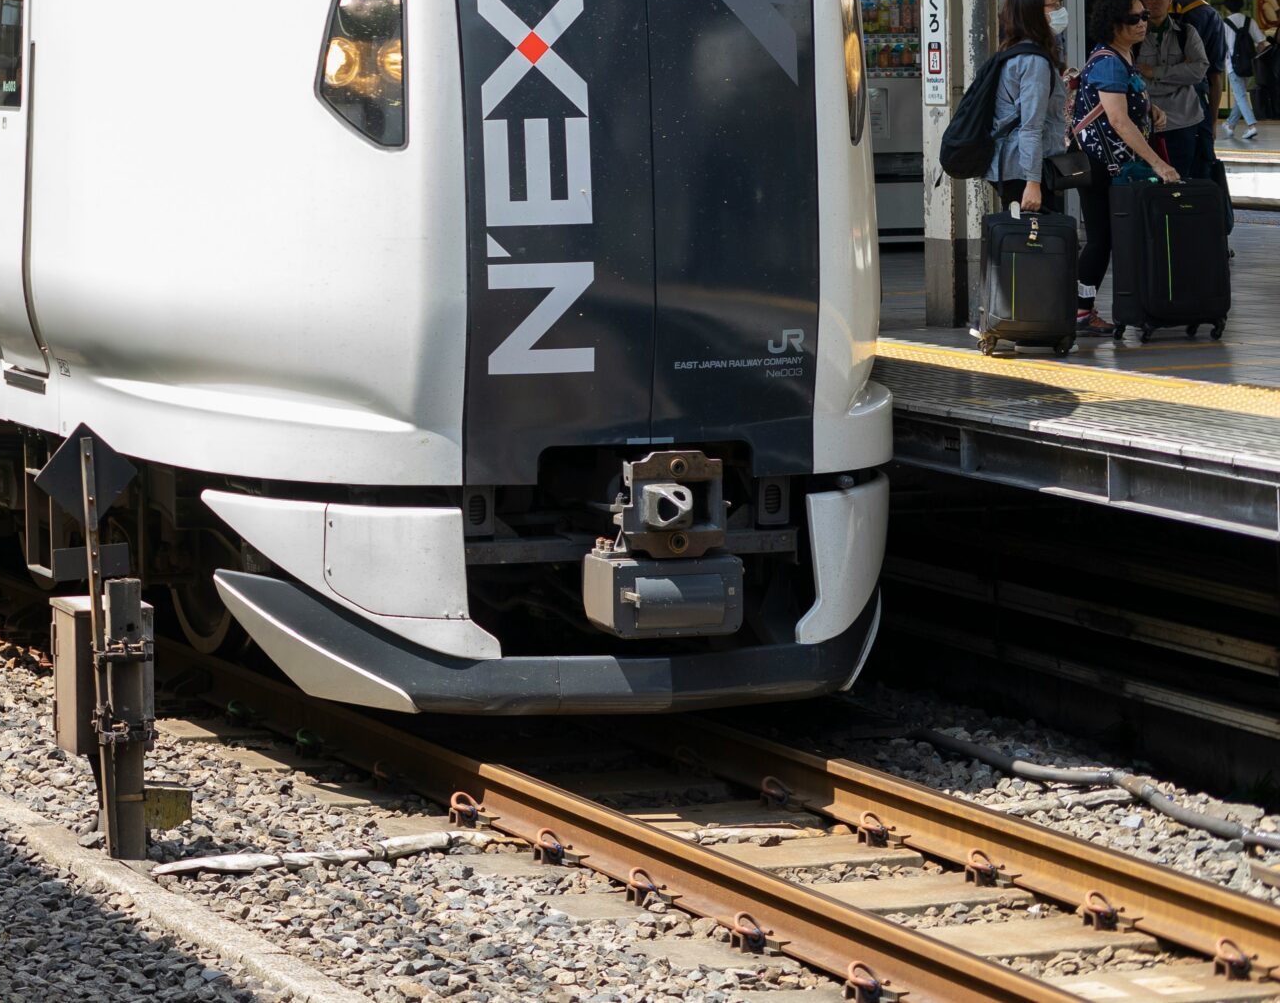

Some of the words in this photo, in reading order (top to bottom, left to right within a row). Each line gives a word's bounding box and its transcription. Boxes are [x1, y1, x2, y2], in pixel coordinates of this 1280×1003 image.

[767, 328, 805, 354] JR
[674, 360, 698, 370] EAST
[698, 359, 727, 369] JAPAN
[728, 358, 763, 368] RAILWAY
[763, 356, 803, 366] COMPANY
[766, 367, 803, 378] Ne003
